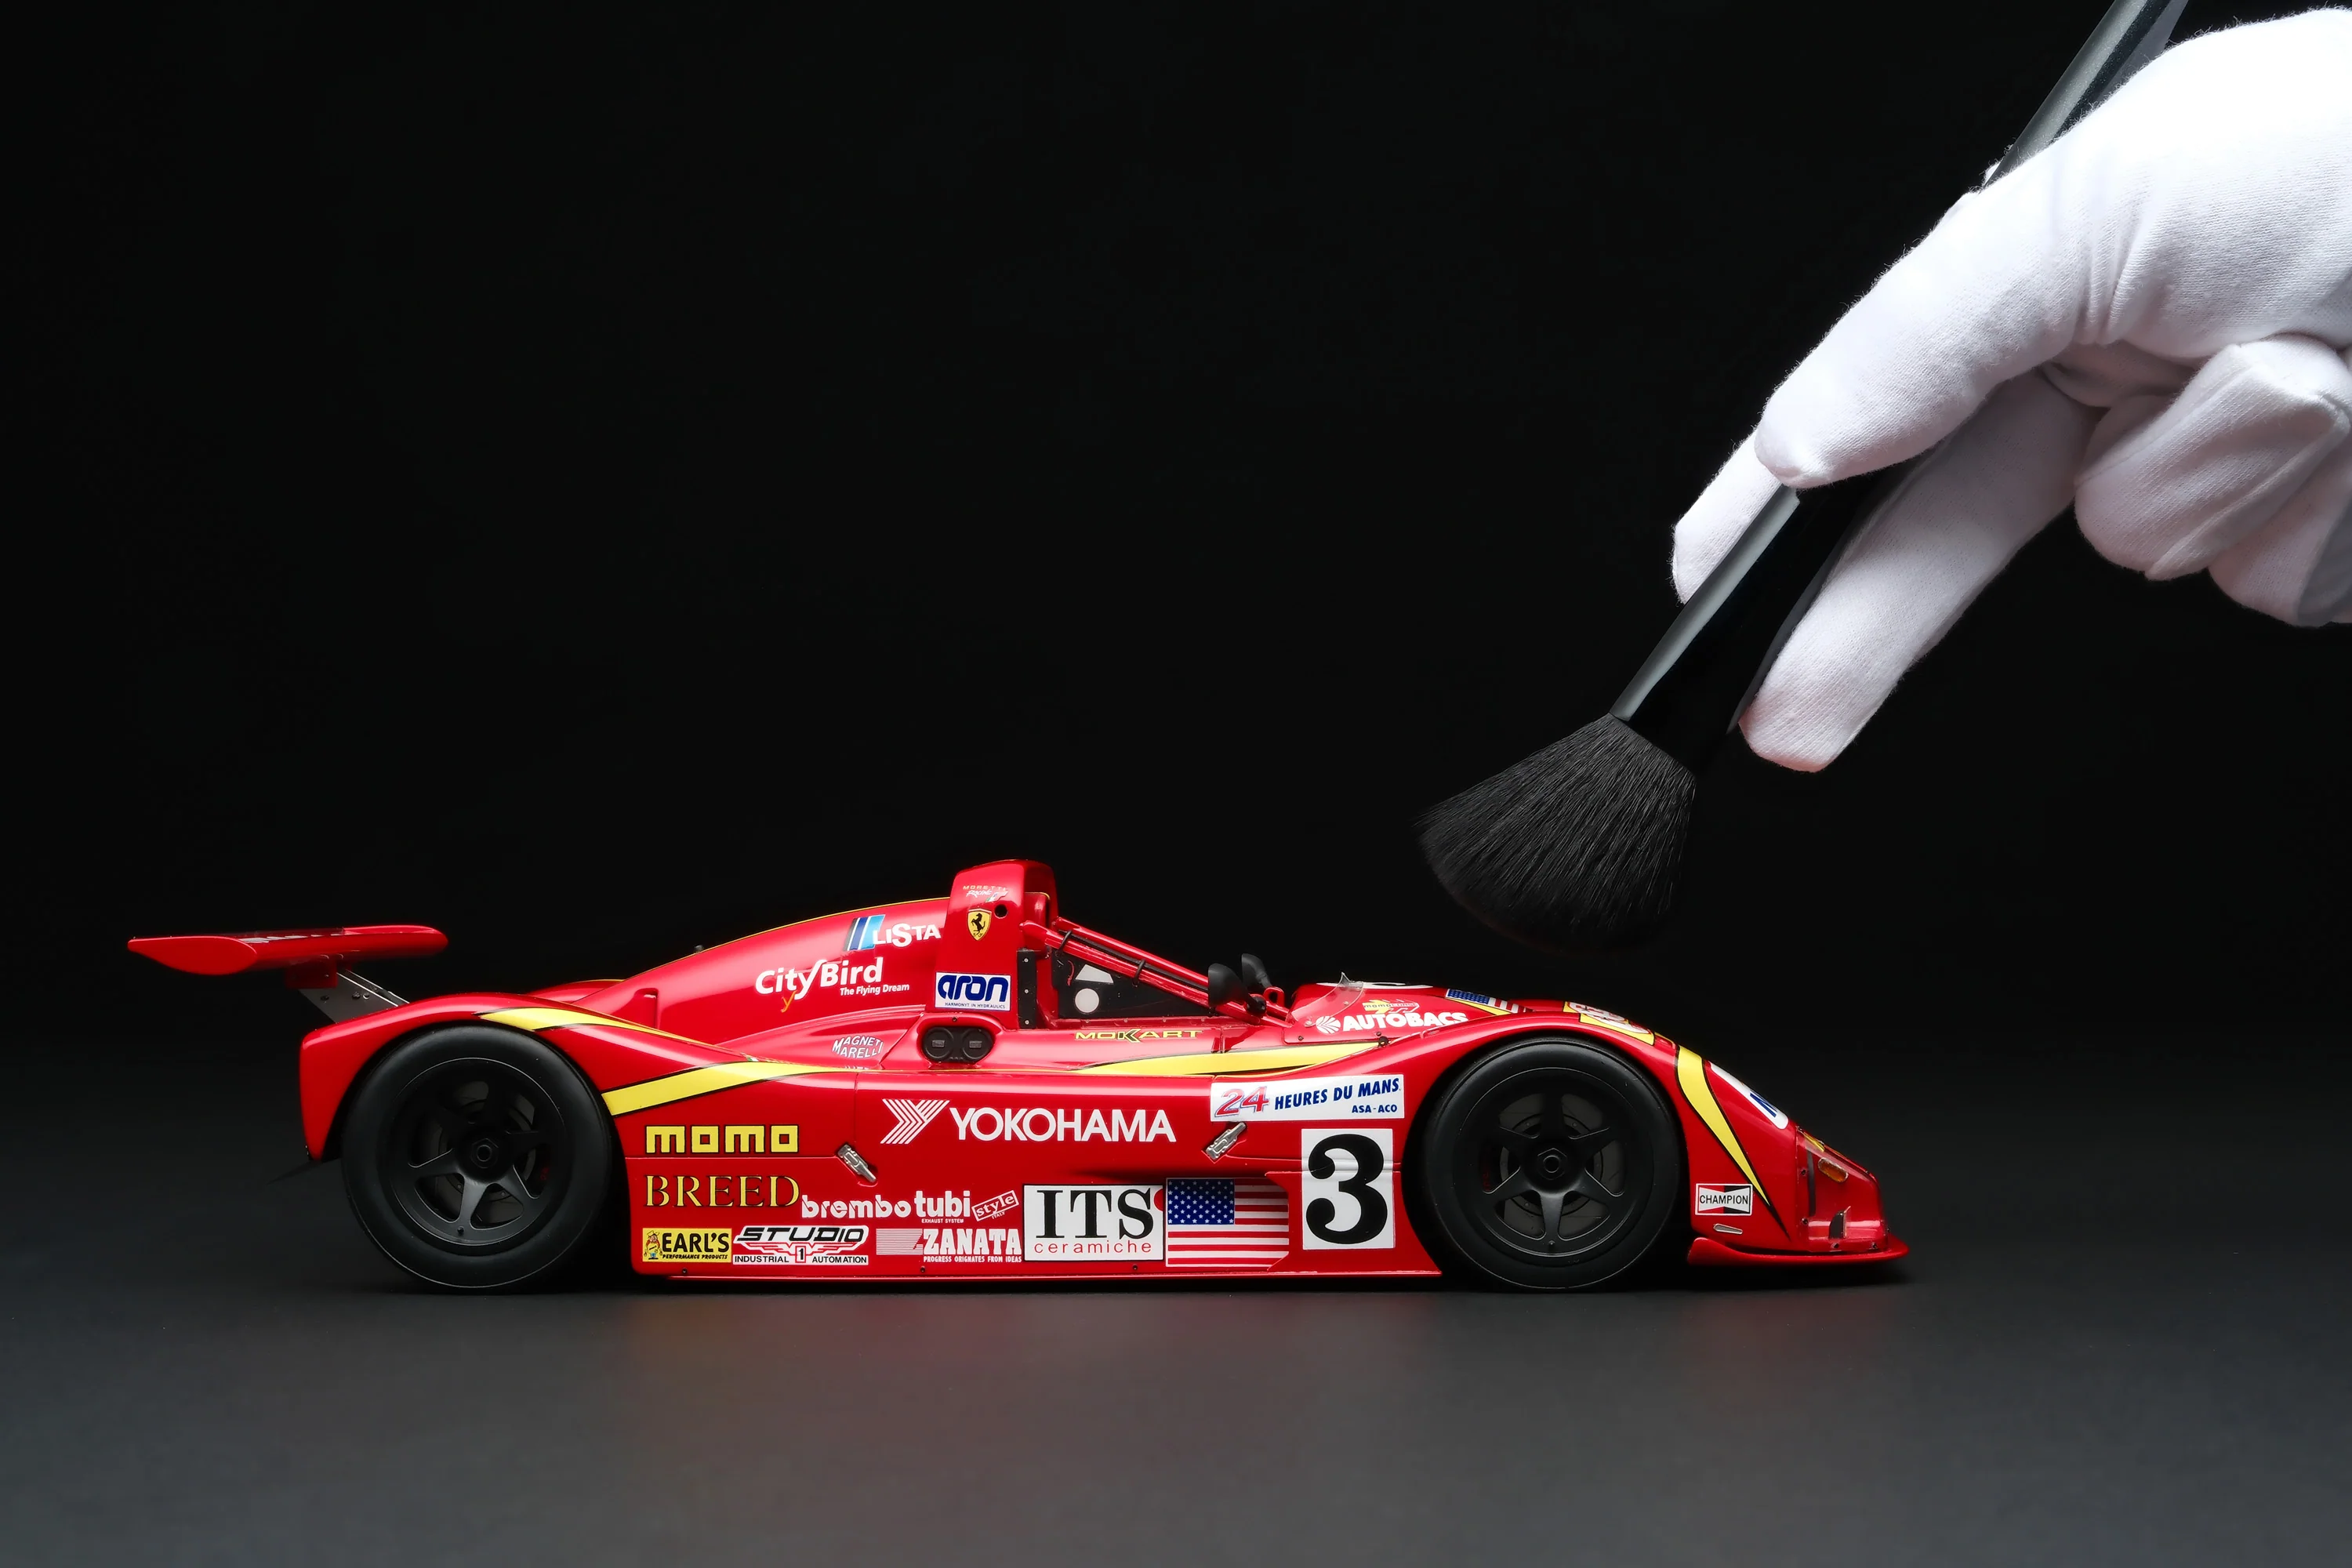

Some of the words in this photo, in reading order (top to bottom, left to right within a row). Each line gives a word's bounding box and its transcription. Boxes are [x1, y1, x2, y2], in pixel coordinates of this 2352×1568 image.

[856, 985, 881, 996] Flying
[883, 984, 909, 993] Dream
[938, 975, 1009, 1002] aron
[1343, 1012, 1469, 1032] AUTOBACS
[832, 1036, 884, 1053] MAGNETI
[1215, 1086, 1269, 1117] 24
[1275, 1088, 1327, 1110] HEURES
[1334, 1085, 1352, 1101] DU
[1358, 1078, 1399, 1098] MANS
[949, 1107, 1177, 1142] YOKOHAMA
[644, 1175, 800, 1207] BREED
[1306, 1134, 1388, 1245] 3
[1699, 1195, 1748, 1204] CHAMPION
[801, 1195, 912, 1218] brembo
[914, 1190, 971, 1218] tubi
[977, 1193, 1015, 1217] style
[991, 1210, 1006, 1220] ITALY
[1036, 1188, 1153, 1240] ITS
[662, 1232, 730, 1253] EARL'S
[737, 1227, 864, 1243] STUDIO
[923, 1229, 1022, 1255] ZANATA
[798, 1248, 804, 1261] 1
[1034, 1240, 1152, 1254] ceramiche
